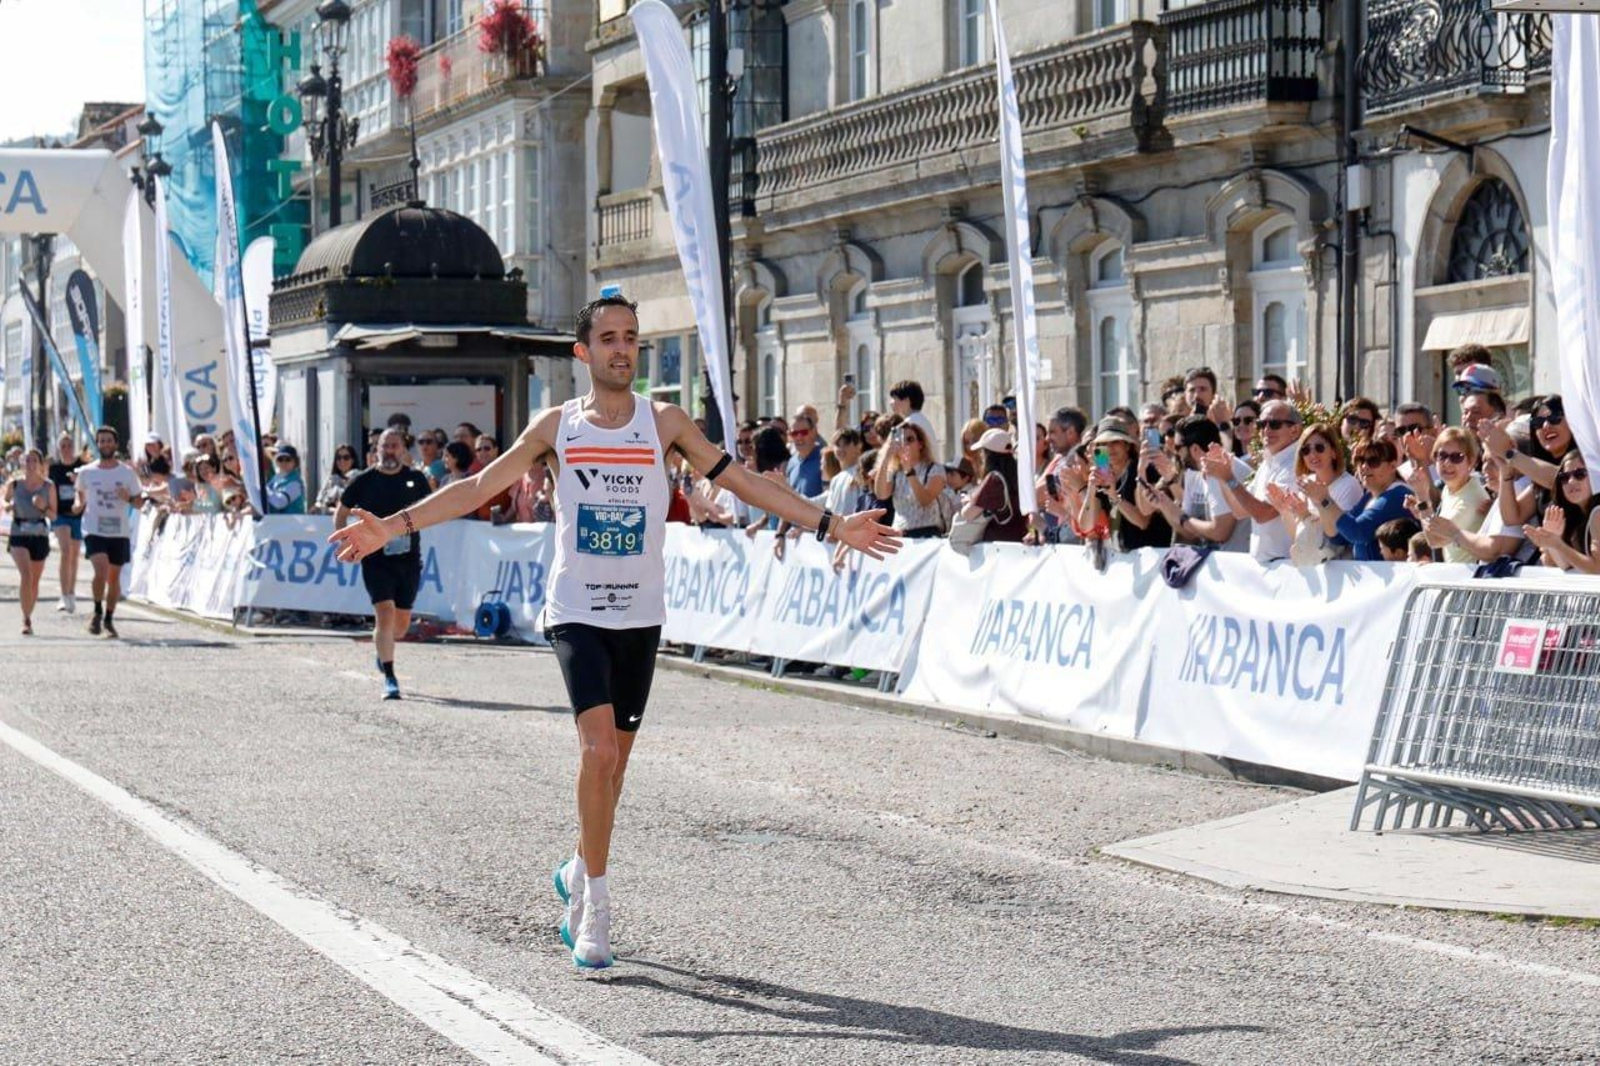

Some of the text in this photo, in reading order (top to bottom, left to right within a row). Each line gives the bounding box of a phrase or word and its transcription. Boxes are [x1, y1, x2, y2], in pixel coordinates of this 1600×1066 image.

[267, 31, 302, 264] HOTE
[0, 169, 47, 214] A
[602, 474, 643, 485] VICKY
[258, 539, 443, 593] ABAA
[589, 531, 636, 550] 3819
[779, 566, 906, 635] ABANCA
[977, 599, 1096, 669] ABANCA
[1188, 615, 1346, 705] ABANCA
